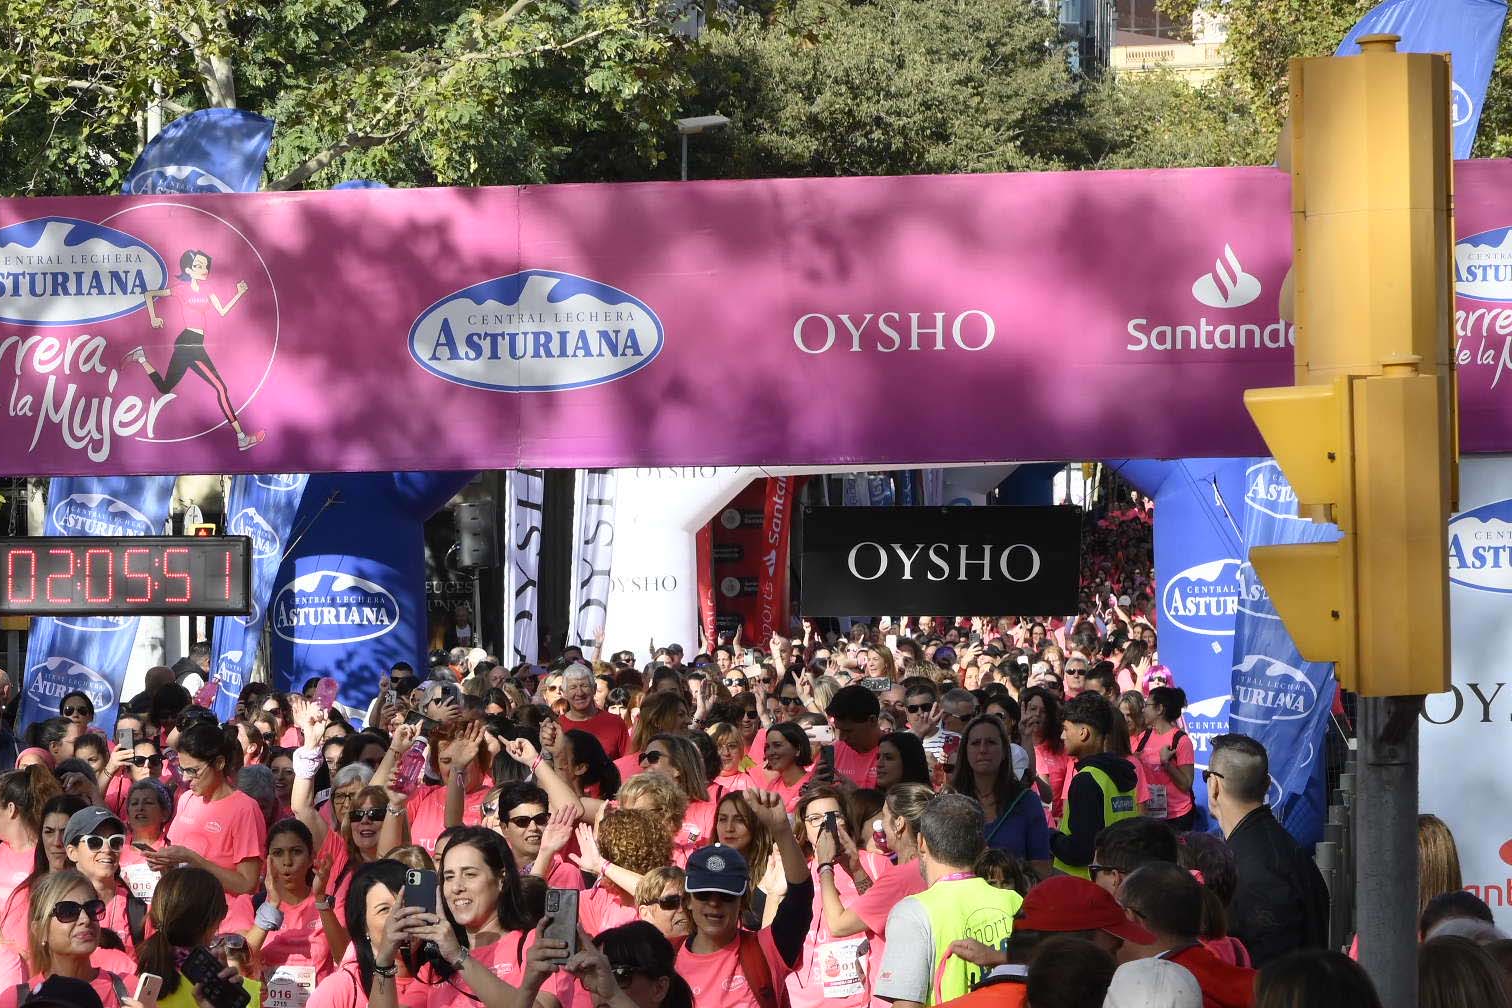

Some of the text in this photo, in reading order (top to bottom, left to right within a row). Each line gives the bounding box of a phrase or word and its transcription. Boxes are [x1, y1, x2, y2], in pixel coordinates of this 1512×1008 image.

[70, 252, 144, 265] LECHERA
[467, 309, 636, 327] CENTRAL LECHERA
[792, 309, 997, 355] OYSHO
[428, 316, 645, 362] ASTURIANA
[9, 377, 33, 418] la
[28, 368, 178, 464] Mujer
[7, 549, 231, 603] 02:05:51
[848, 541, 1041, 582] OYSHO
[1186, 585, 1237, 594] CENTRAL
[277, 601, 390, 627] ASTURIANA
[270, 989, 292, 999] 016
